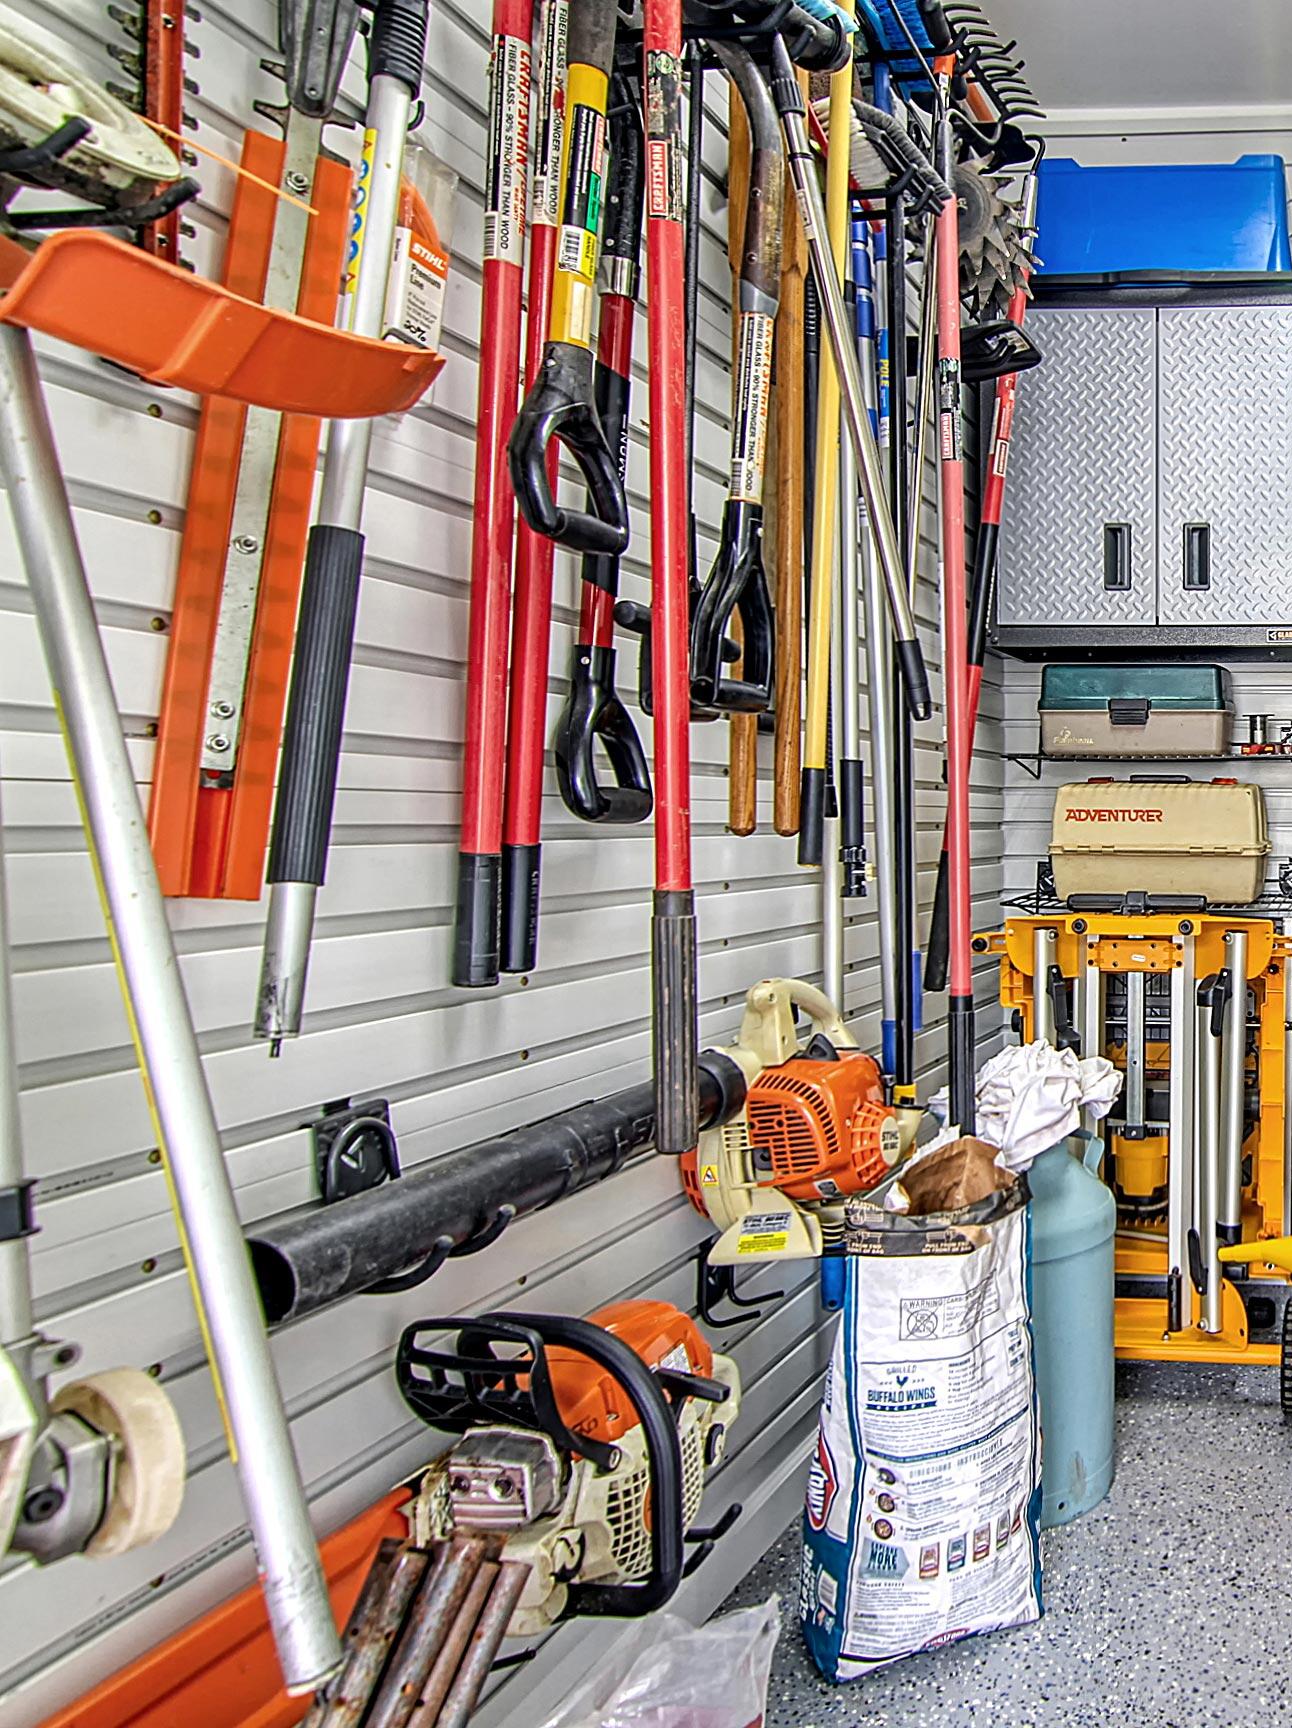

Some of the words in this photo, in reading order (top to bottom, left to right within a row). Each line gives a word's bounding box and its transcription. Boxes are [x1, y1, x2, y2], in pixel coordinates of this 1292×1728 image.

[558, 8, 568, 35] FIBER
[508, 43, 517, 72] FIBER
[557, 38, 566, 69] GLASS
[506, 74, 516, 105] GLASS
[516, 49, 532, 167] CRAFTSMAN
[504, 113, 513, 133] 90%
[551, 156, 560, 182] THAN
[652, 144, 663, 212] CRAFTSMAN
[502, 190, 511, 216] THAN
[549, 185, 558, 215] WOOD
[500, 219, 509, 250] WOOD
[411, 242, 447, 271] STIHL
[756, 315, 764, 339] FIBER
[754, 341, 763, 367] GLASS
[880, 359, 889, 388] POLE
[749, 393, 758, 437] STRONGER
[942, 415, 951, 457] CRAFTSMAN
[747, 441, 755, 462] THAN
[745, 468, 753, 491] OOD
[1064, 808, 1163, 823] ADVENTURER
[881, 1130, 899, 1142] STIHL
[909, 1300, 943, 1310] WARNING
[867, 1388, 905, 1404] BUFFALO
[906, 1386, 937, 1402] WINGS
[869, 1549, 898, 1566] MORE
